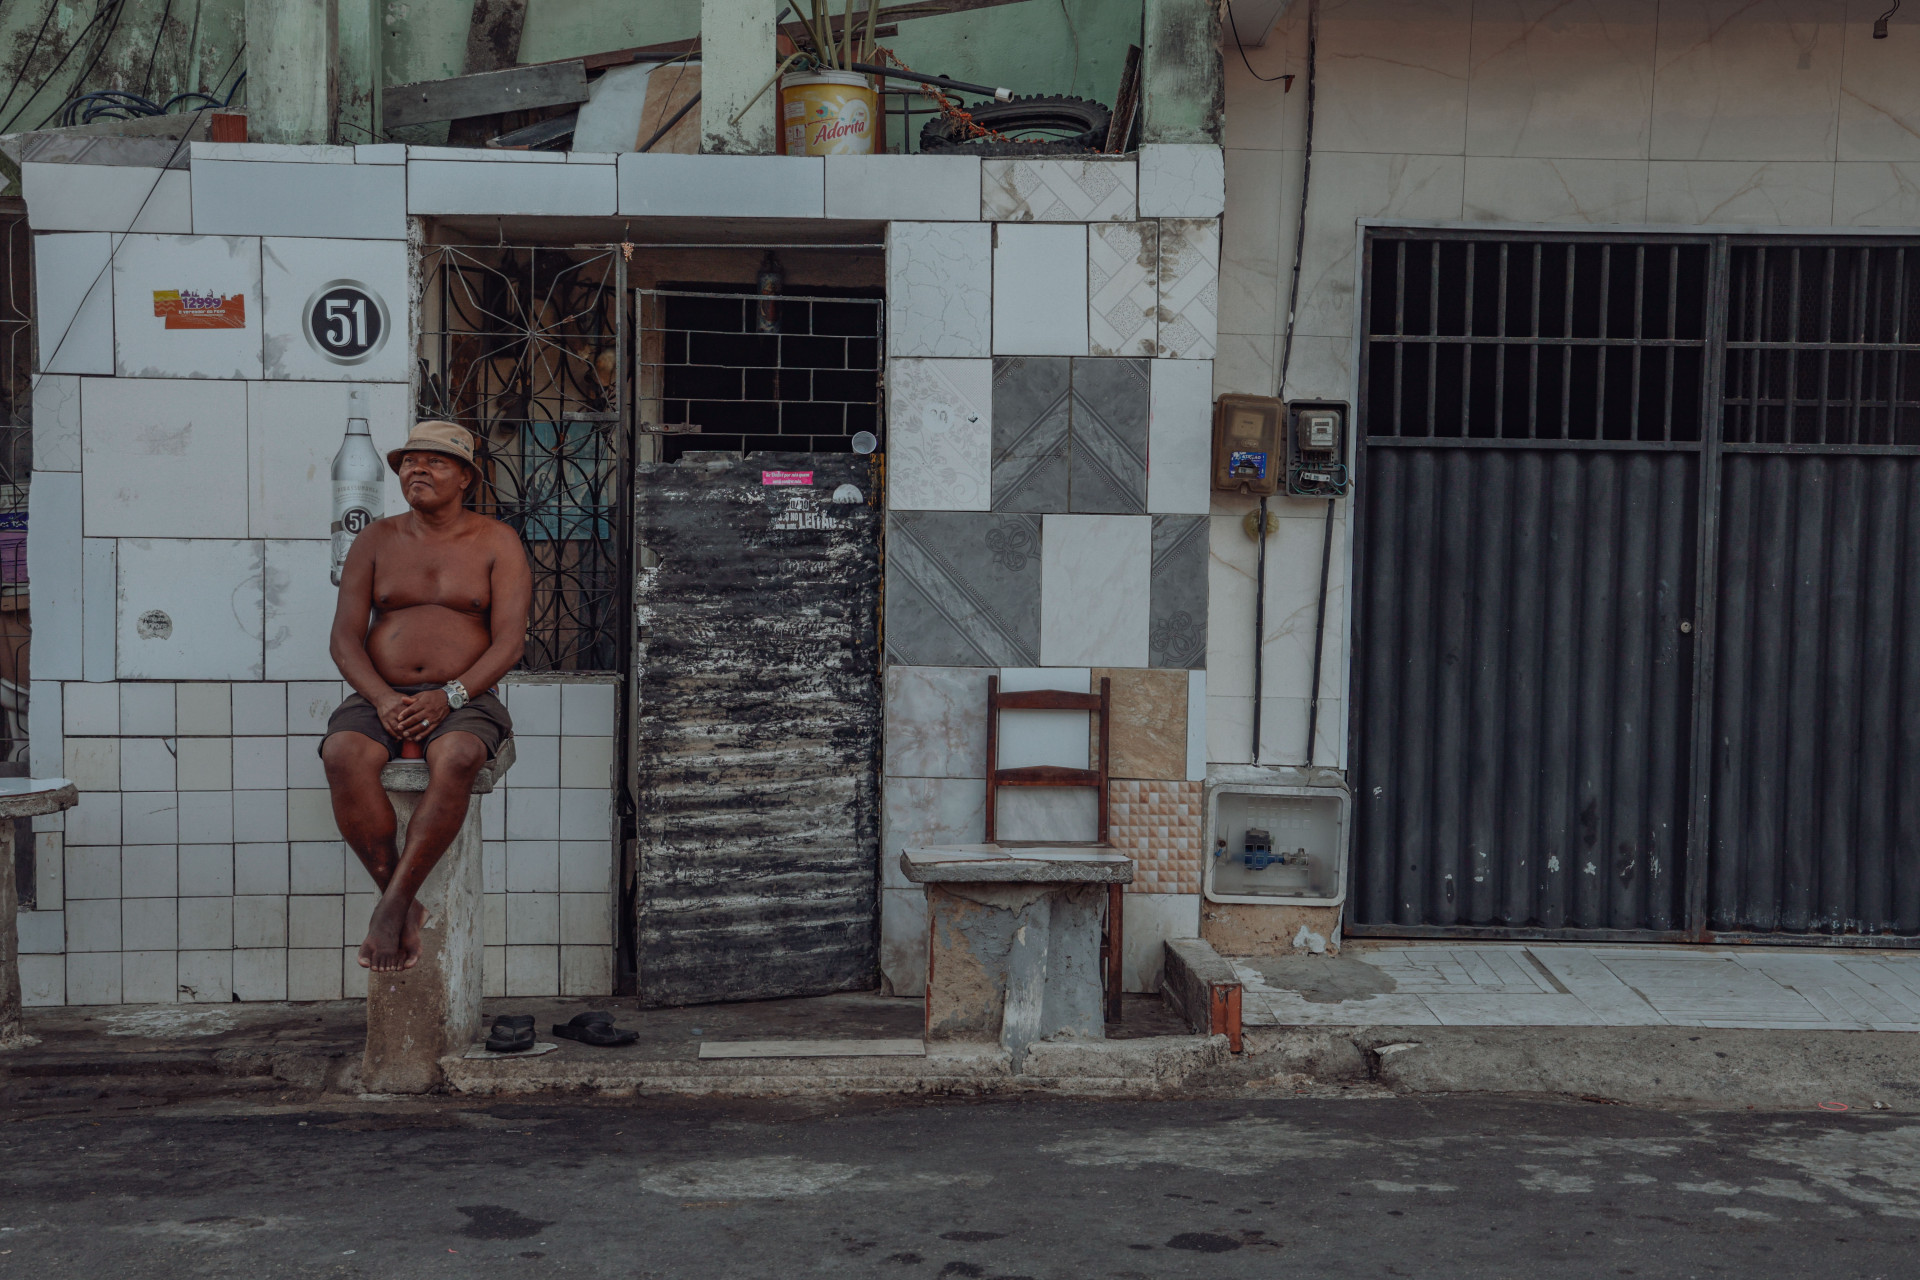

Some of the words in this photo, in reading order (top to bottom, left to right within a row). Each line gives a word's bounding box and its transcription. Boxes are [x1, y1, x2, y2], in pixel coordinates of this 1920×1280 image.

[813, 120, 865, 145] Adorita
[182, 297, 221, 309] 12999
[325, 299, 368, 348] 51
[349, 512, 366, 531] 51
